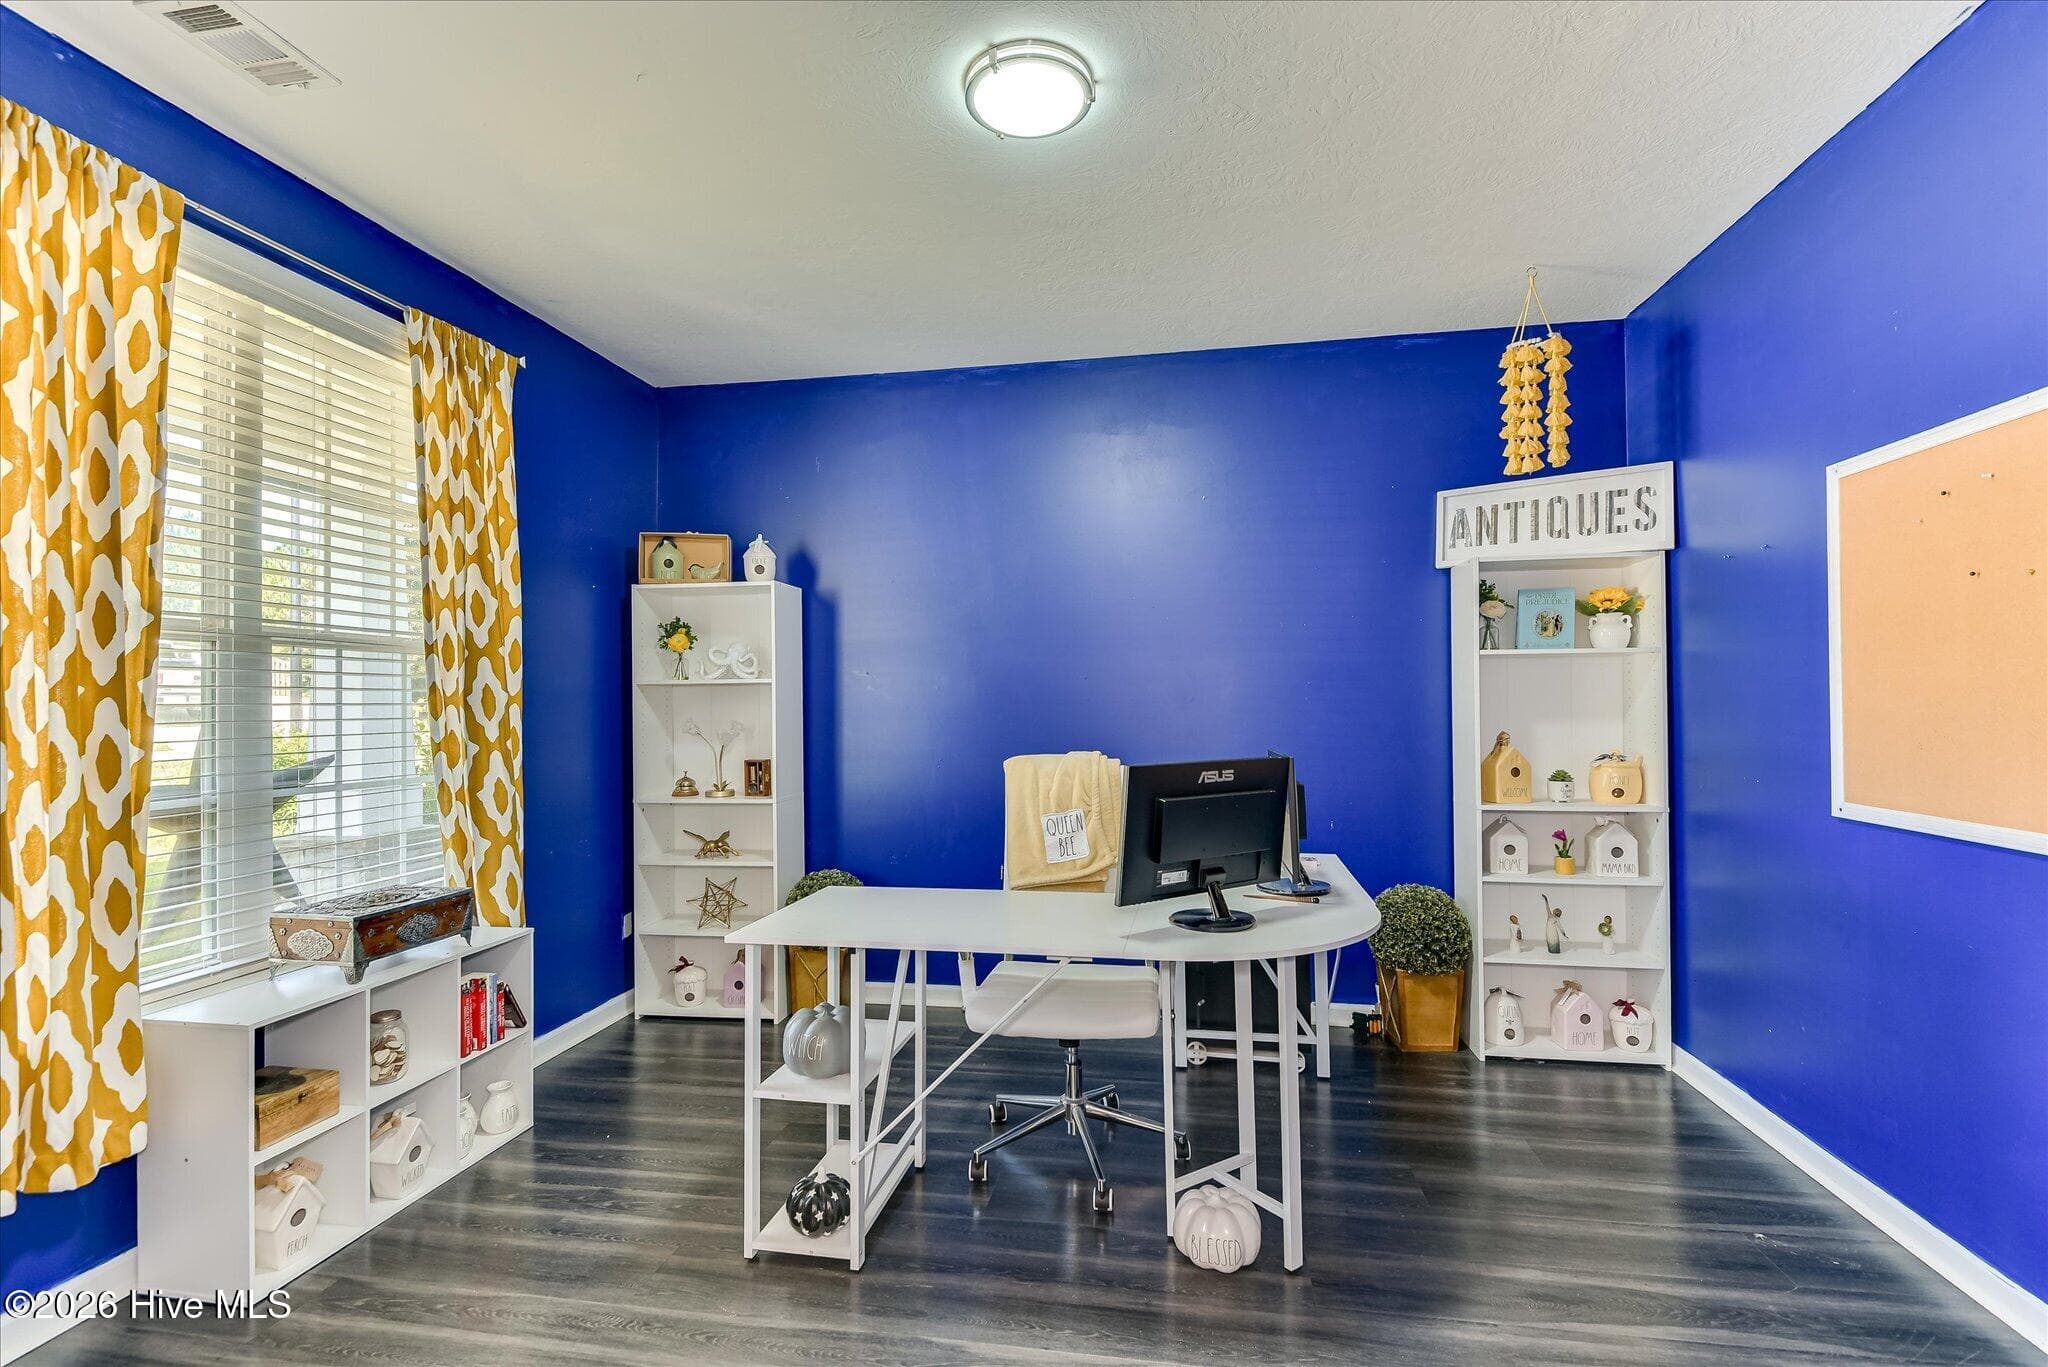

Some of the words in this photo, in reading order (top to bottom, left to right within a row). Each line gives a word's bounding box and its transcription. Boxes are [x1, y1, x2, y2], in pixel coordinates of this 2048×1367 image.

[1449, 486, 1657, 549] ANTIQUES
[1198, 769, 1236, 784] ASUS
[1046, 813, 1083, 837] QUEEN
[1059, 836, 1077, 857] BEE
[1499, 859, 1523, 872] HOME
[1602, 863, 1622, 873] MAMA
[788, 1032, 826, 1061] WITCH
[1572, 1032, 1597, 1046] HOME
[287, 1233, 308, 1258] PEACH
[1190, 1234, 1242, 1267] BLESSED
